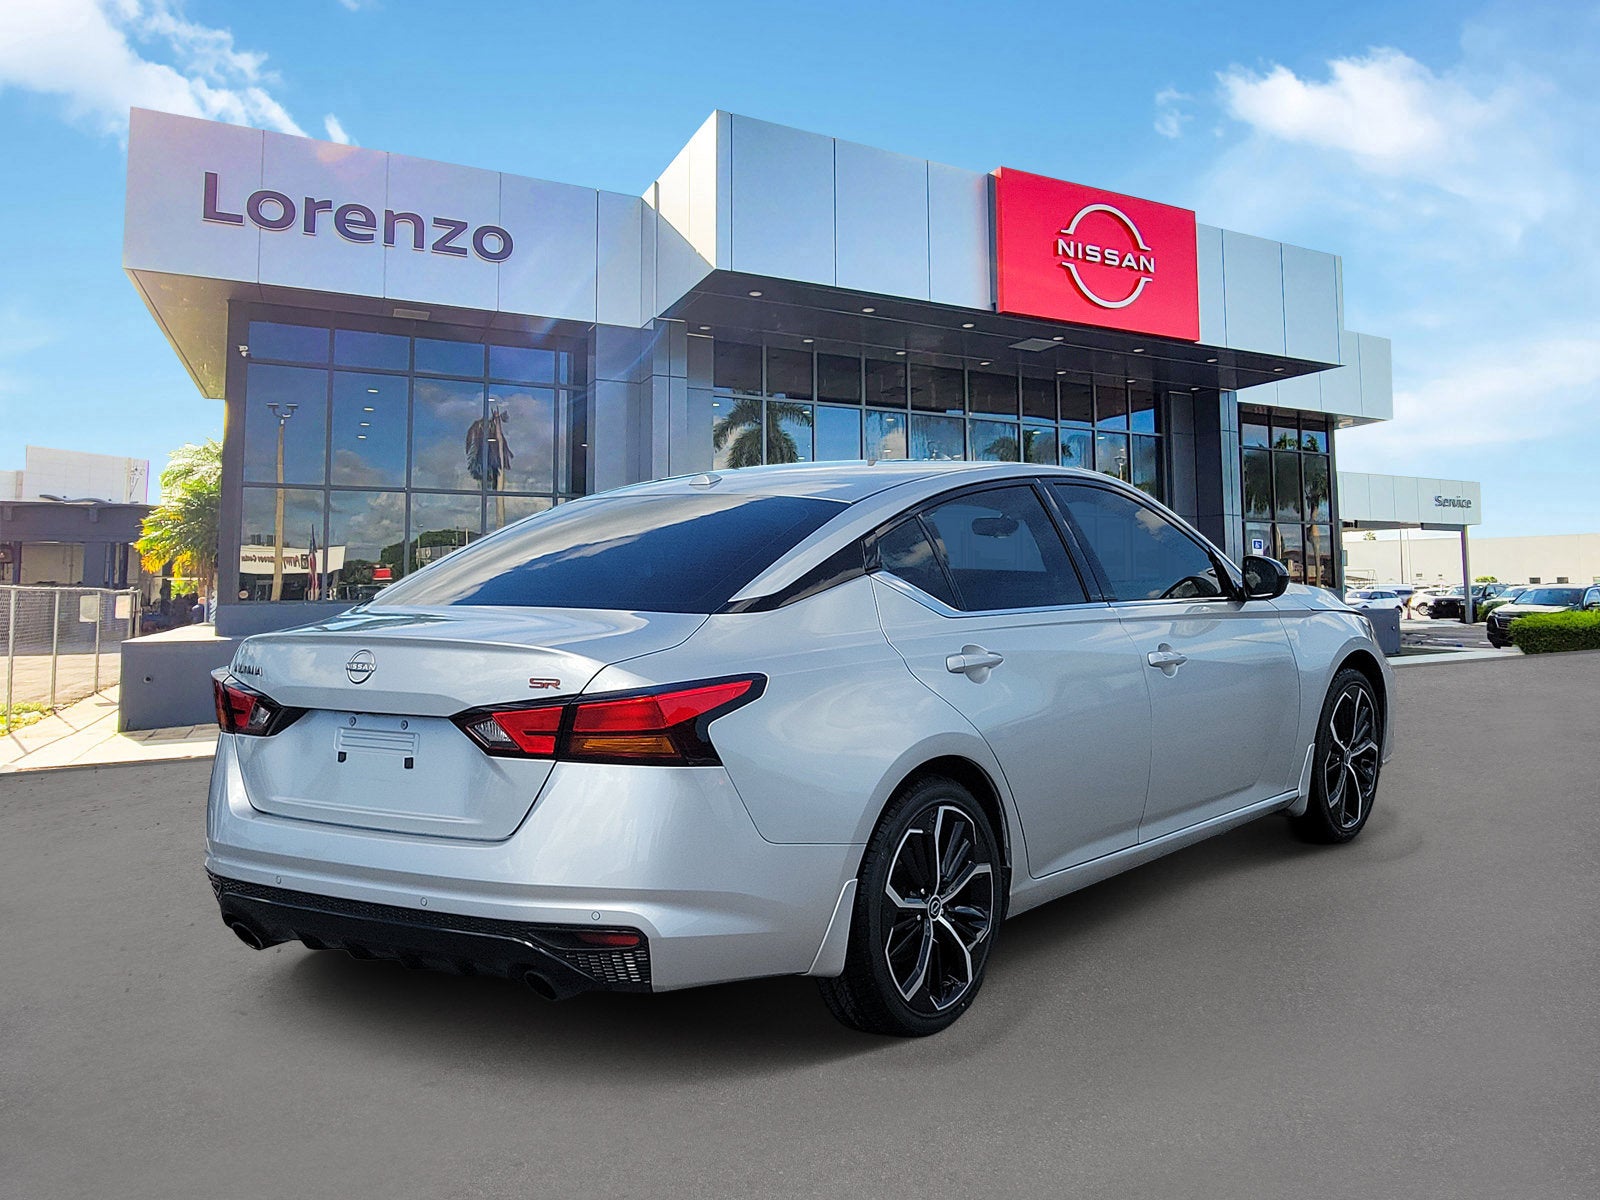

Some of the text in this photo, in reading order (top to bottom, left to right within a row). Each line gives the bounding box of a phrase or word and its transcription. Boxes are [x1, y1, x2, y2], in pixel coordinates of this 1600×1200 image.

[203, 171, 514, 262] Lorenzo
[1057, 238, 1155, 273] NISSAN
[1434, 495, 1472, 509] Service
[346, 662, 377, 672] NISSAN
[529, 677, 561, 690] SR
